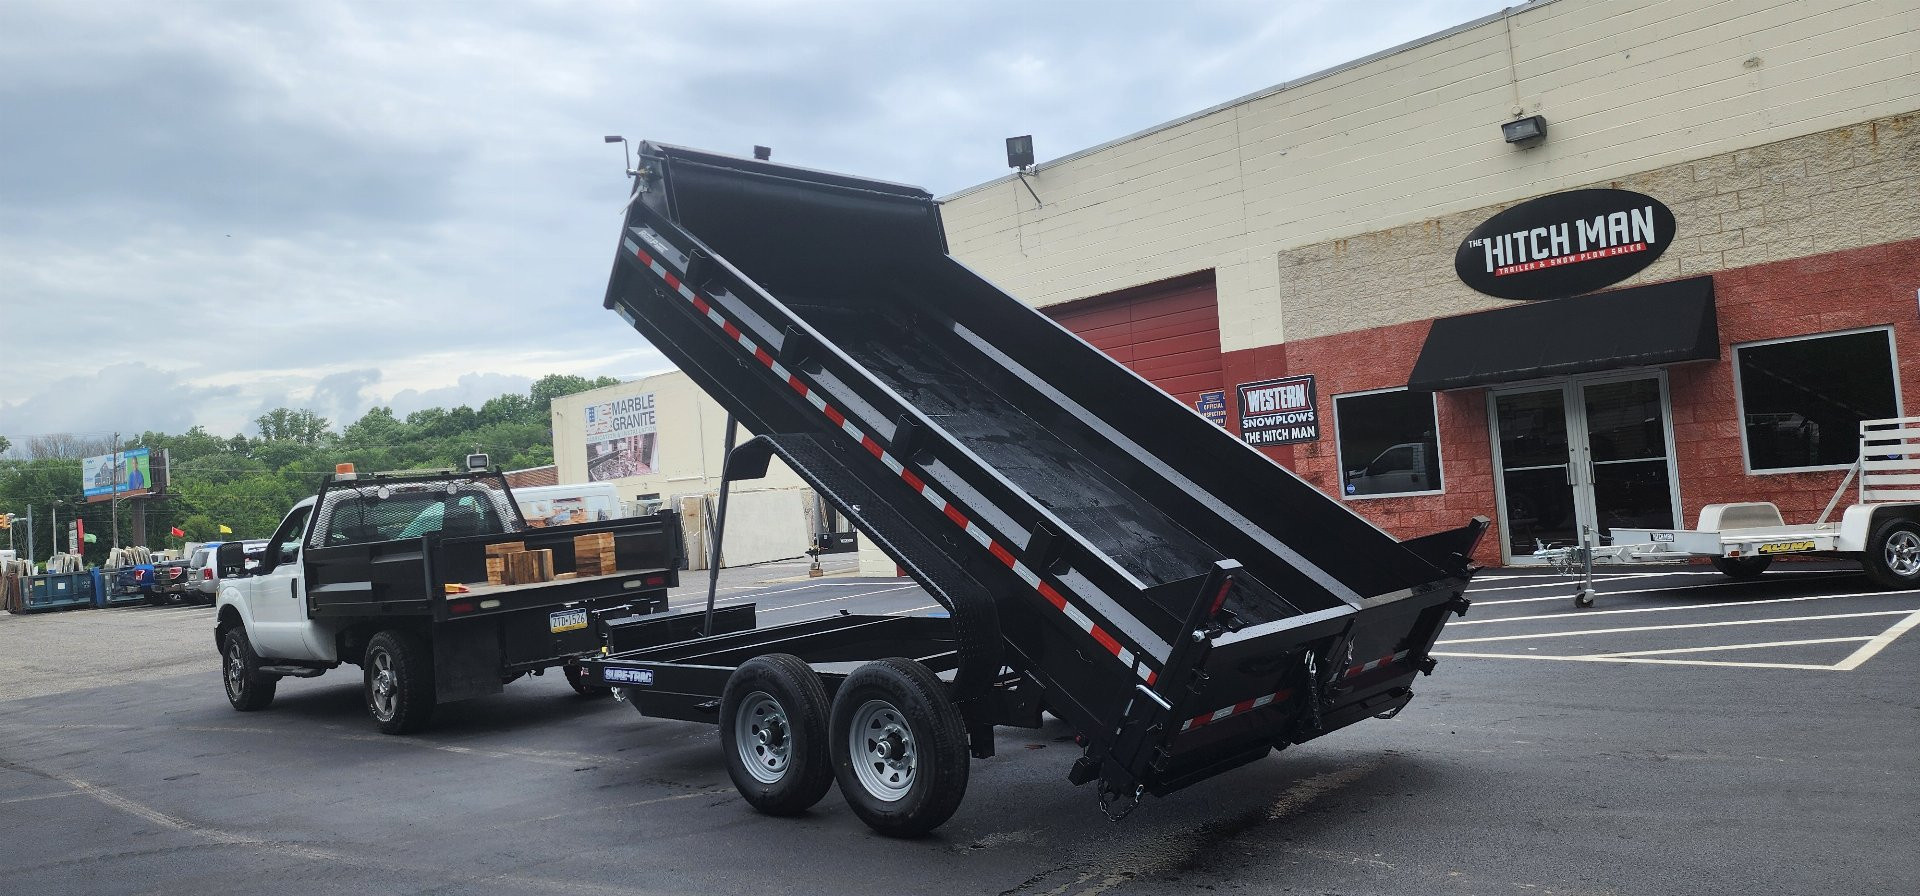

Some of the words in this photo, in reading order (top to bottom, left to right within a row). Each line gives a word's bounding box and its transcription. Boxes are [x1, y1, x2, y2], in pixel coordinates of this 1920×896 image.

[1468, 239, 1483, 248] THE
[1483, 222, 1571, 273] HITCH
[1576, 205, 1656, 252] MAN
[1498, 262, 1535, 275] TRAILER
[1539, 260, 1546, 269] &
[1550, 255, 1577, 266] SNOW
[1580, 249, 1607, 261] PLOW
[1611, 243, 1642, 255] SALES
[612, 394, 654, 415] MARBLE
[1203, 403, 1224, 411] OFFICIAL
[1247, 383, 1306, 412] WESTERN
[612, 411, 656, 431] GRANITE
[1243, 412, 1315, 429] SNOWPLOWS
[1245, 431, 1261, 444] THE
[1263, 428, 1289, 442] HITCH
[1291, 425, 1316, 440] MAN
[1759, 541, 1815, 553] ALUMA
[605, 669, 652, 683] SURE-TRAC
